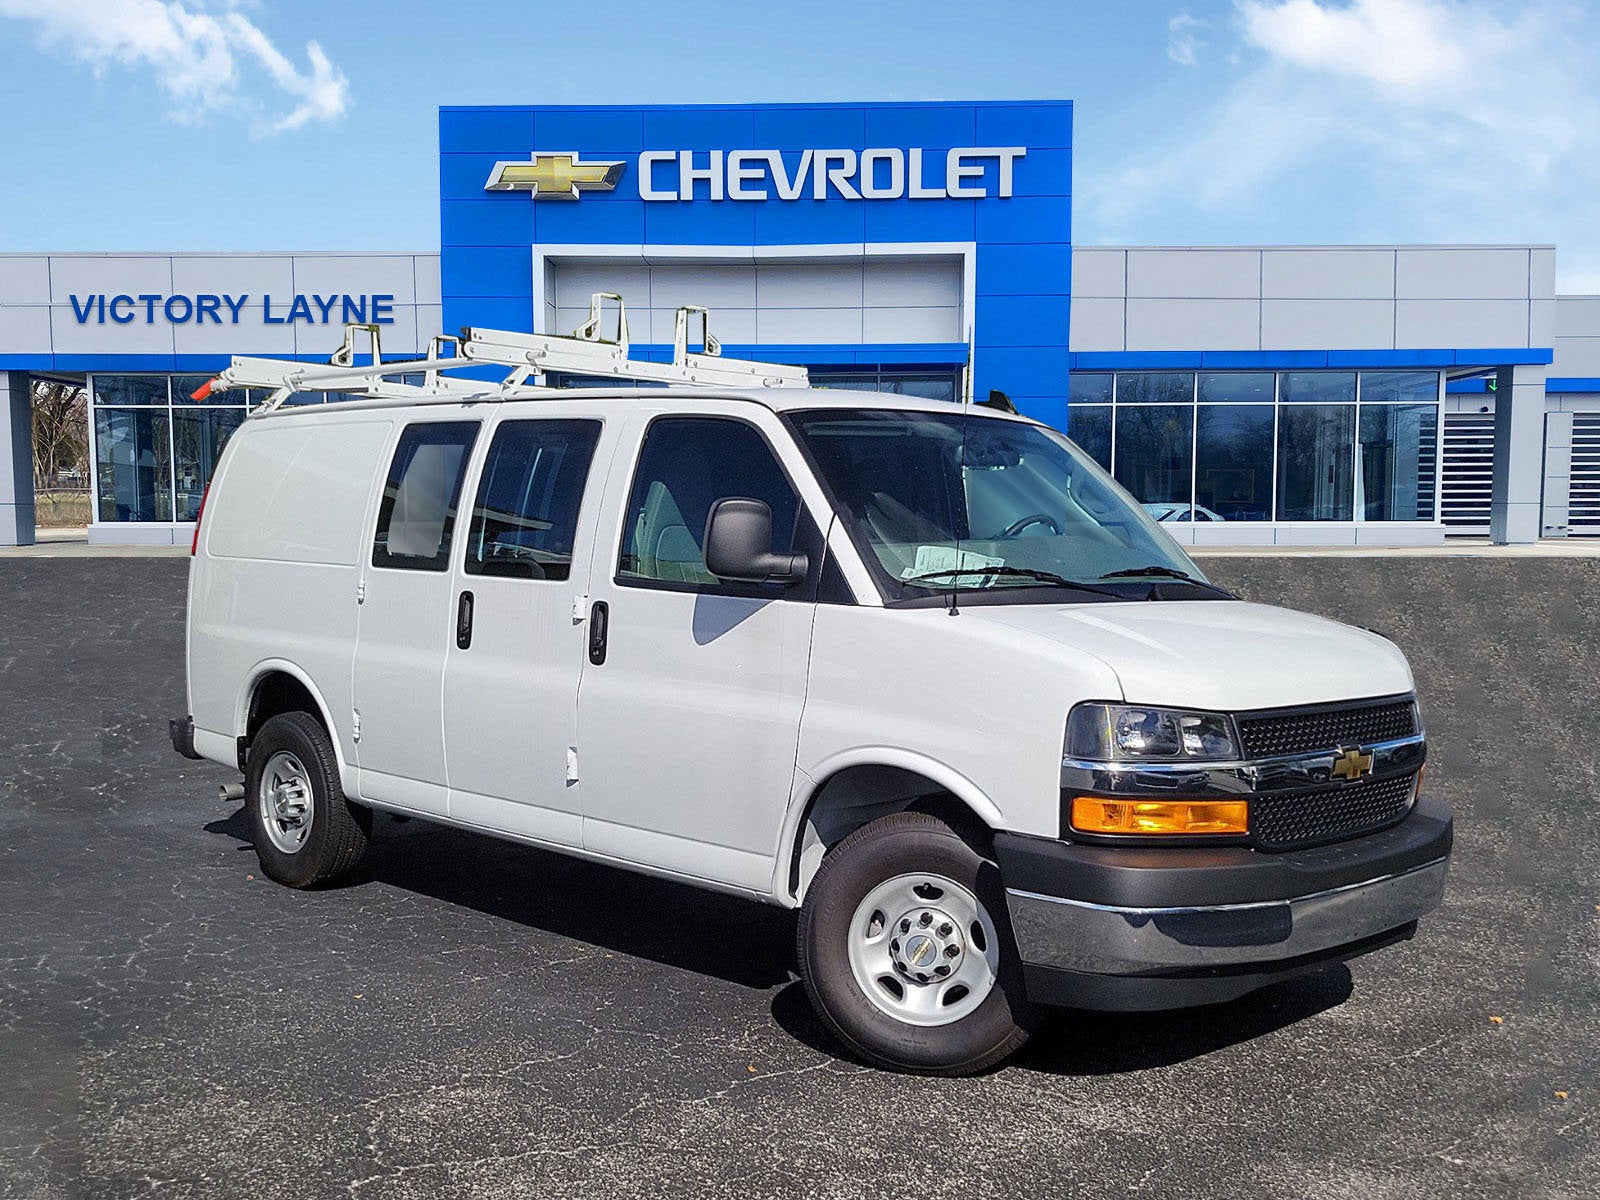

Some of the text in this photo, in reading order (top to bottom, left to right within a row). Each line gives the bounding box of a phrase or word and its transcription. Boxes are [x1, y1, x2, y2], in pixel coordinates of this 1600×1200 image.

[638, 146, 1027, 202] CHEVROLET
[69, 295, 394, 324] VICTORY LAYNE
